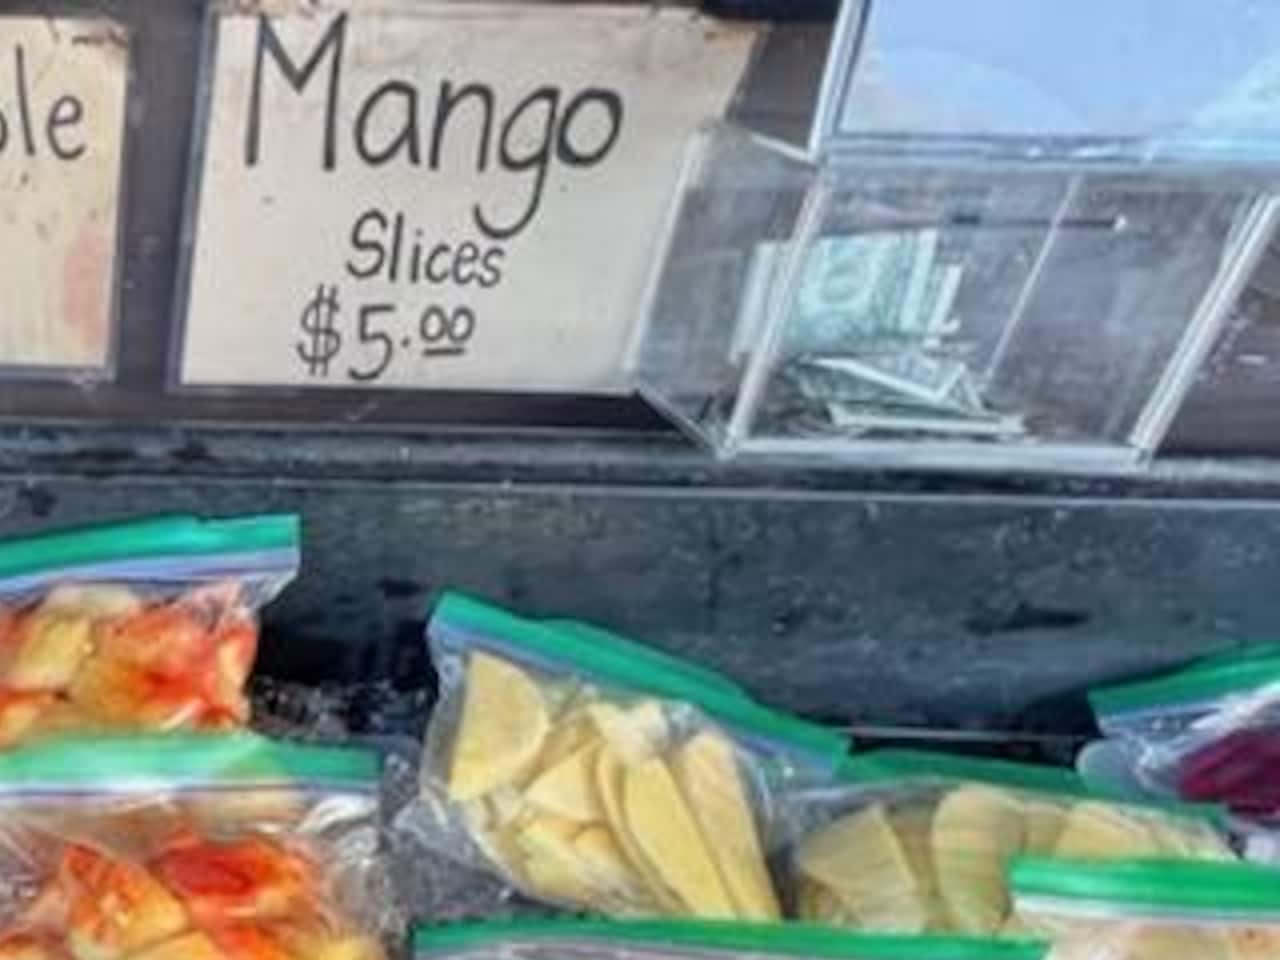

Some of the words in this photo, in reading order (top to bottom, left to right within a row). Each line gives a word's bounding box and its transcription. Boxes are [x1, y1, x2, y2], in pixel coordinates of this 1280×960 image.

[245, 10, 623, 239] Mango
[347, 209, 506, 288] Slices
[296, 284, 475, 381] $5.00
